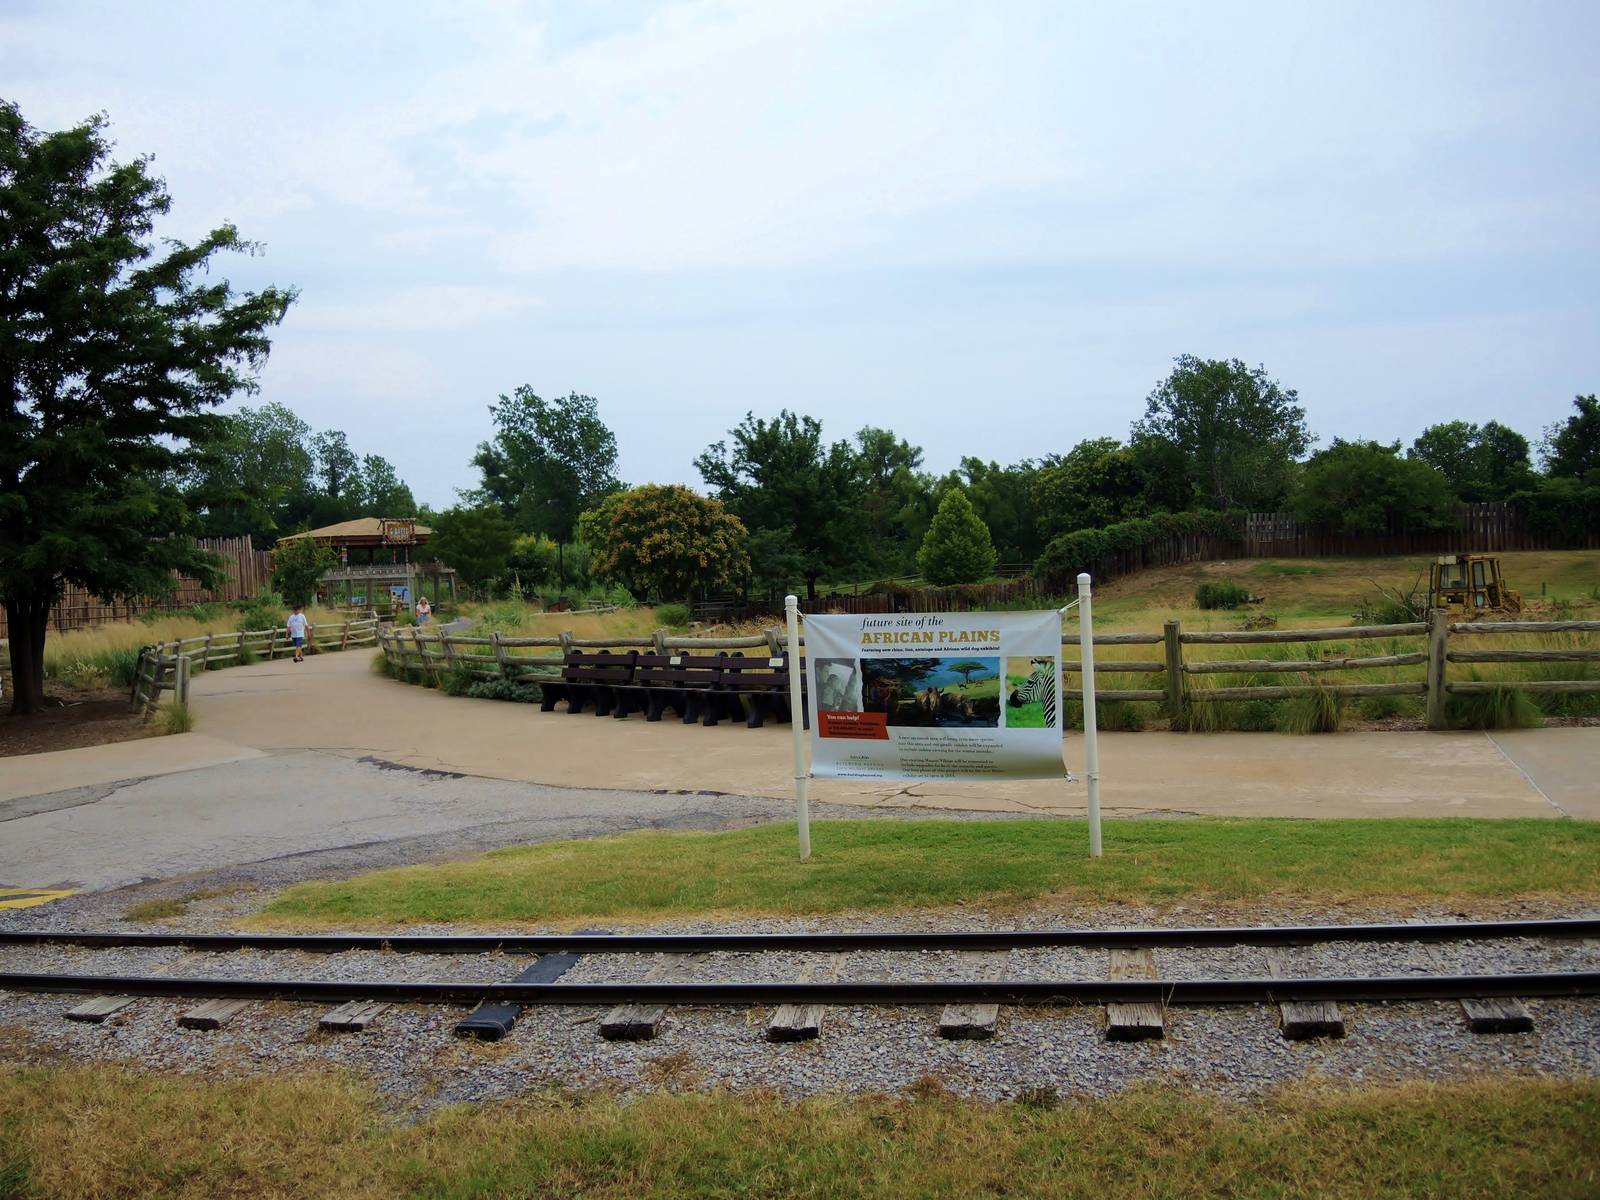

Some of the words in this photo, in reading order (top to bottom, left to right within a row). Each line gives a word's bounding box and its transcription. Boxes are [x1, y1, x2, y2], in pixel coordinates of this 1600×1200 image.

[860, 618, 893, 630] future
[895, 616, 913, 627] site
[915, 616, 928, 630] of
[928, 616, 944, 626] the
[862, 632, 934, 644] AFRICAN
[938, 630, 1000, 642] PLAINS
[846, 714, 860, 722] help!
